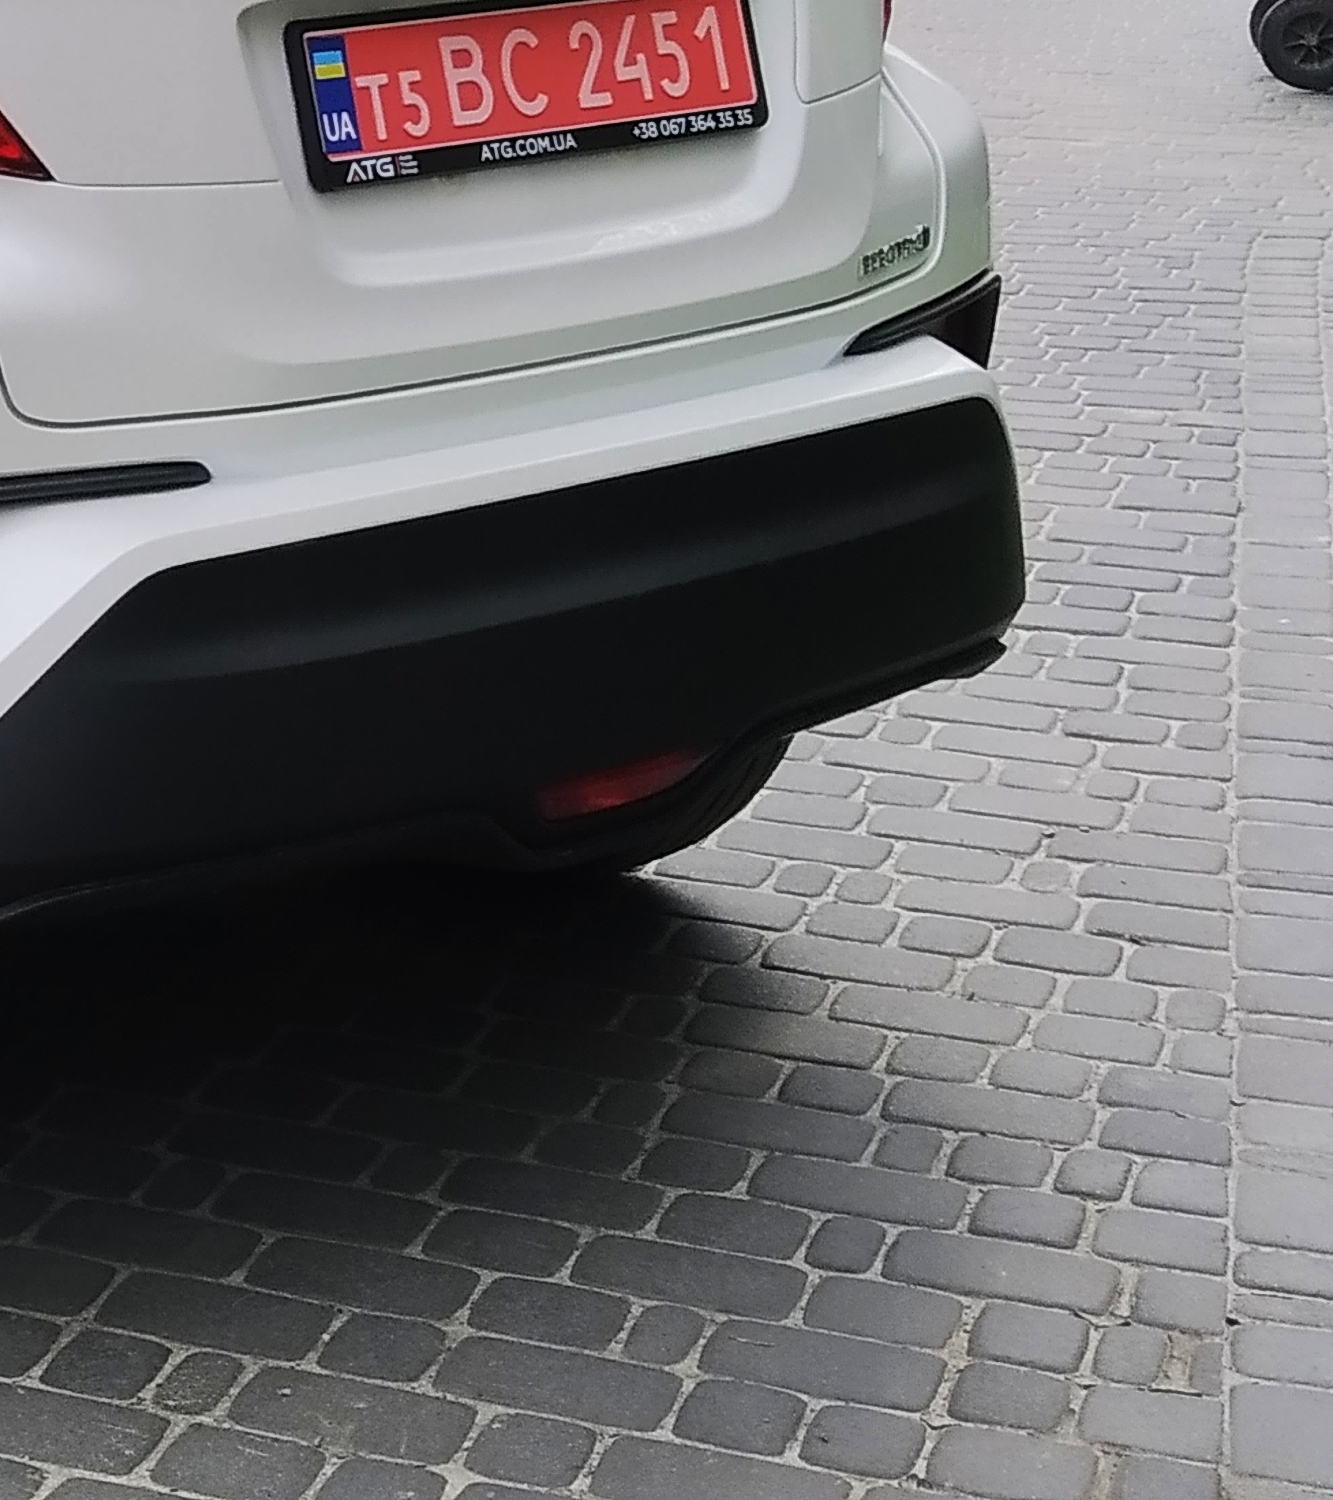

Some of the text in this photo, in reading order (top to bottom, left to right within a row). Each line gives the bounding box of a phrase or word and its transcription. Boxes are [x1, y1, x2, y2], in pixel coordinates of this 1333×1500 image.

[355, 5, 730, 143] T5 BC 2451
[323, 112, 357, 142] UA
[659, 117, 686, 137] 067
[688, 114, 716, 132] 364
[716, 110, 734, 129] 35
[735, 108, 753, 126] 35
[480, 133, 578, 162] ATG.COM.UA
